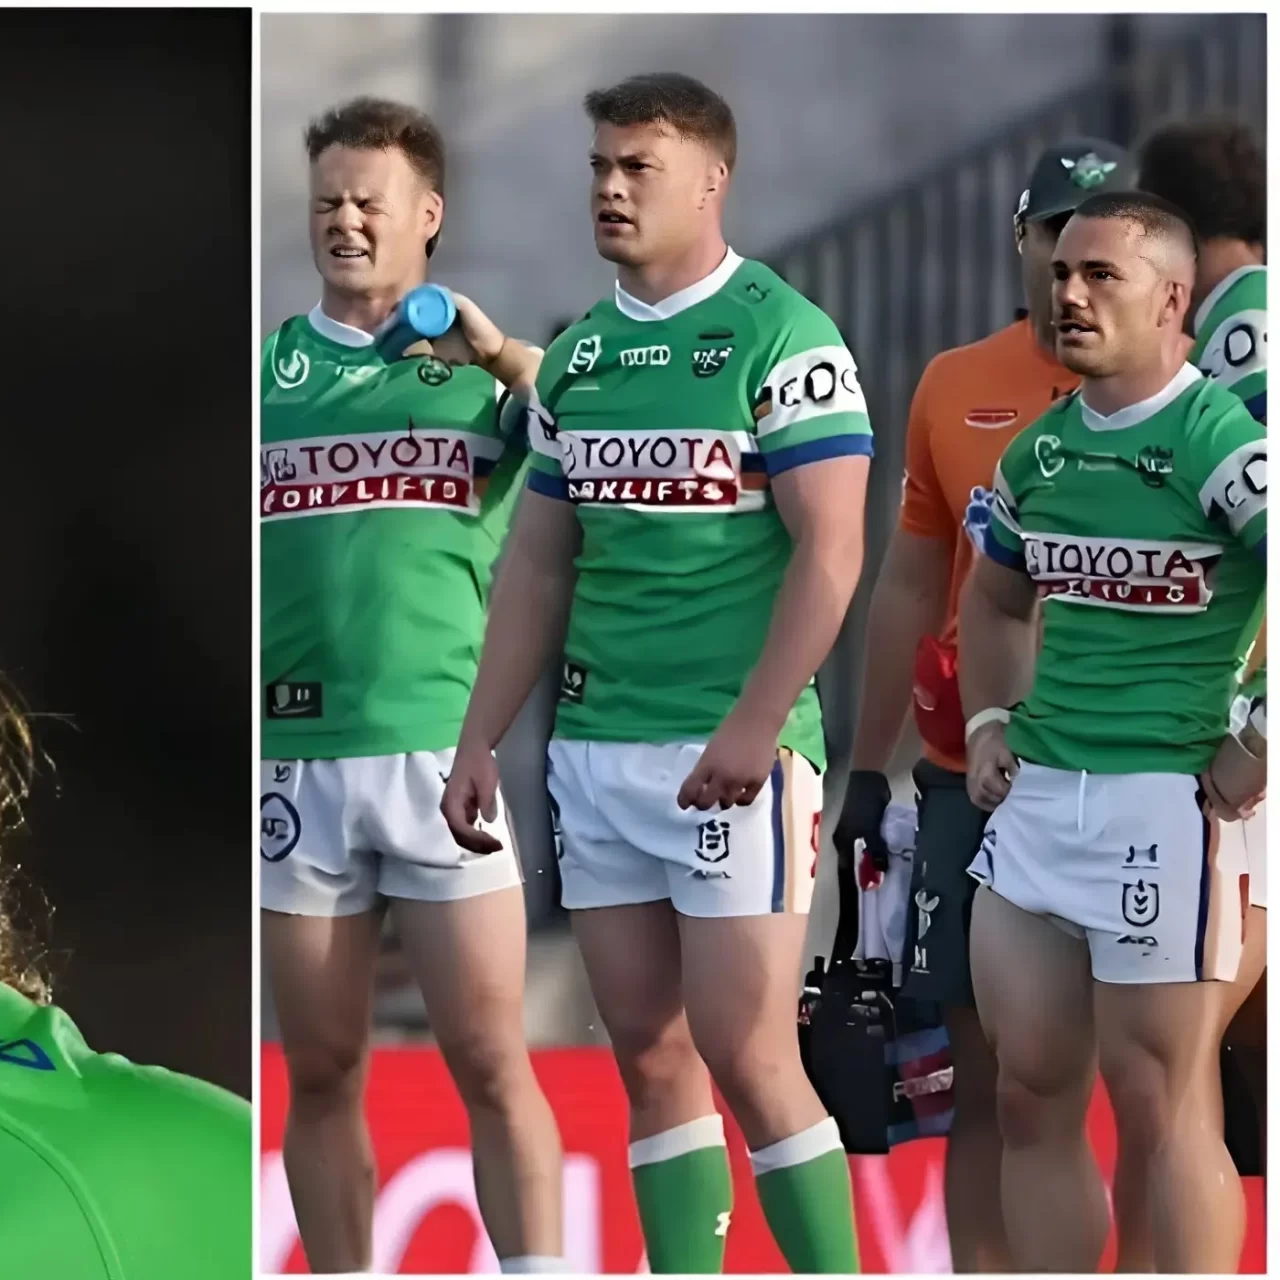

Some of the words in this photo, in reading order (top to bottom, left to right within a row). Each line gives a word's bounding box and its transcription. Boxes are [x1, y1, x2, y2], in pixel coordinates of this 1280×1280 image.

[300, 437, 470, 475] TOYOTA
[581, 436, 733, 469] TOYOTA
[1043, 541, 1195, 578] TOYOTA
